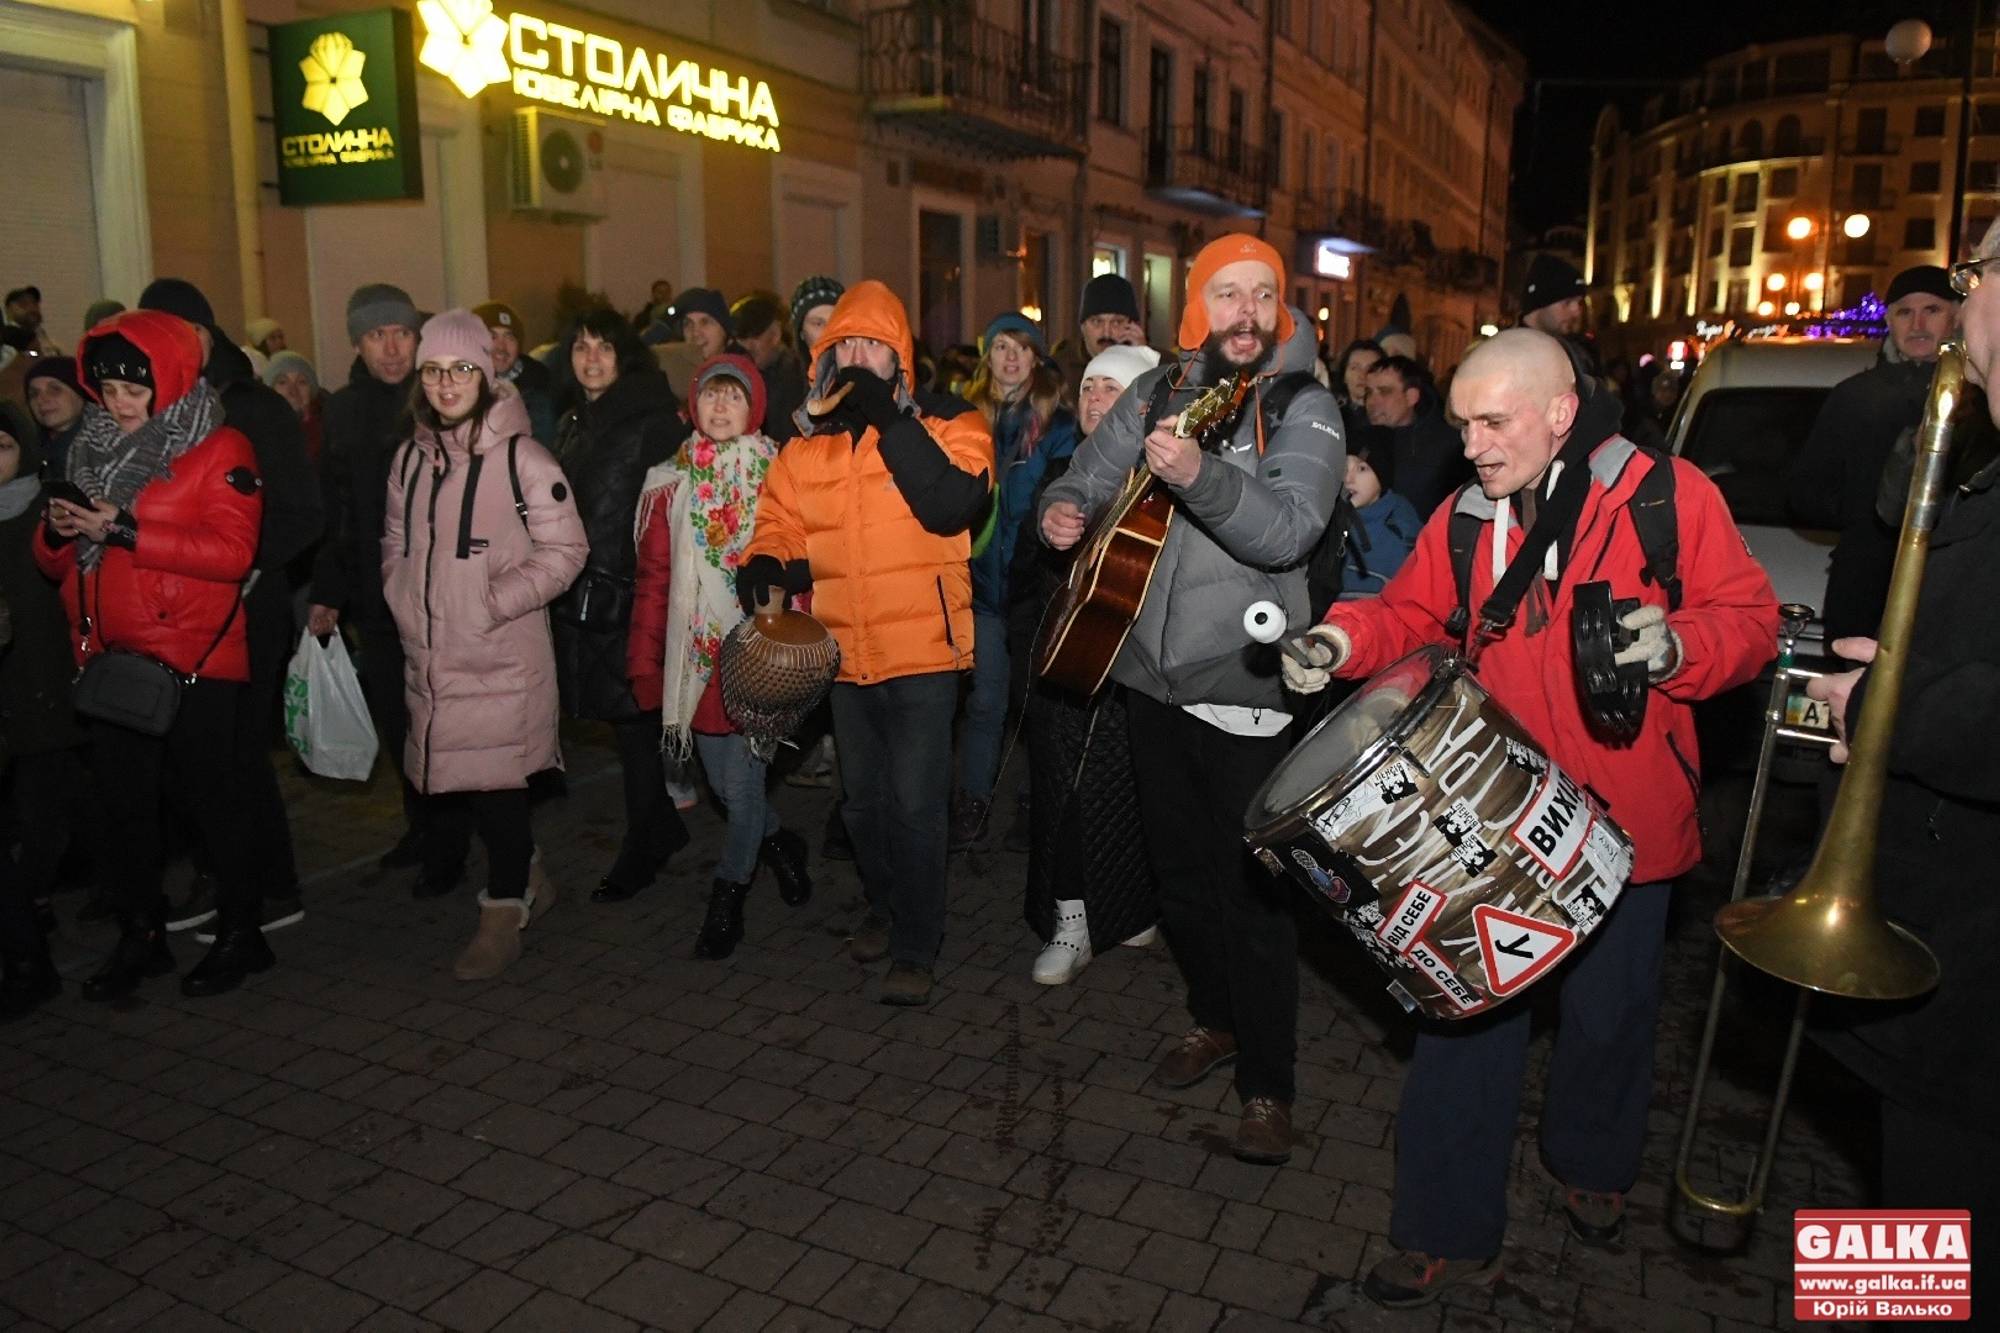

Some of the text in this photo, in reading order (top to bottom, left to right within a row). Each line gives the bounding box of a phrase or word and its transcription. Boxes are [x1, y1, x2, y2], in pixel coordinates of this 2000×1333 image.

[508, 12, 779, 127] СТОЛИЧНА
[513, 67, 781, 152] ЮВЕЛІРНА ФАБРИКА
[282, 127, 394, 157] СТОЛИЧНА
[1455, 803, 1479, 827] ПЕНСІЯ
[1387, 891, 1431, 946] ВІД СЕБЕ
[1565, 902, 1589, 928] ПЕНСІЯ
[1495, 933, 1534, 960] У
[1411, 949, 1476, 1004] ДО СЕБЕ
